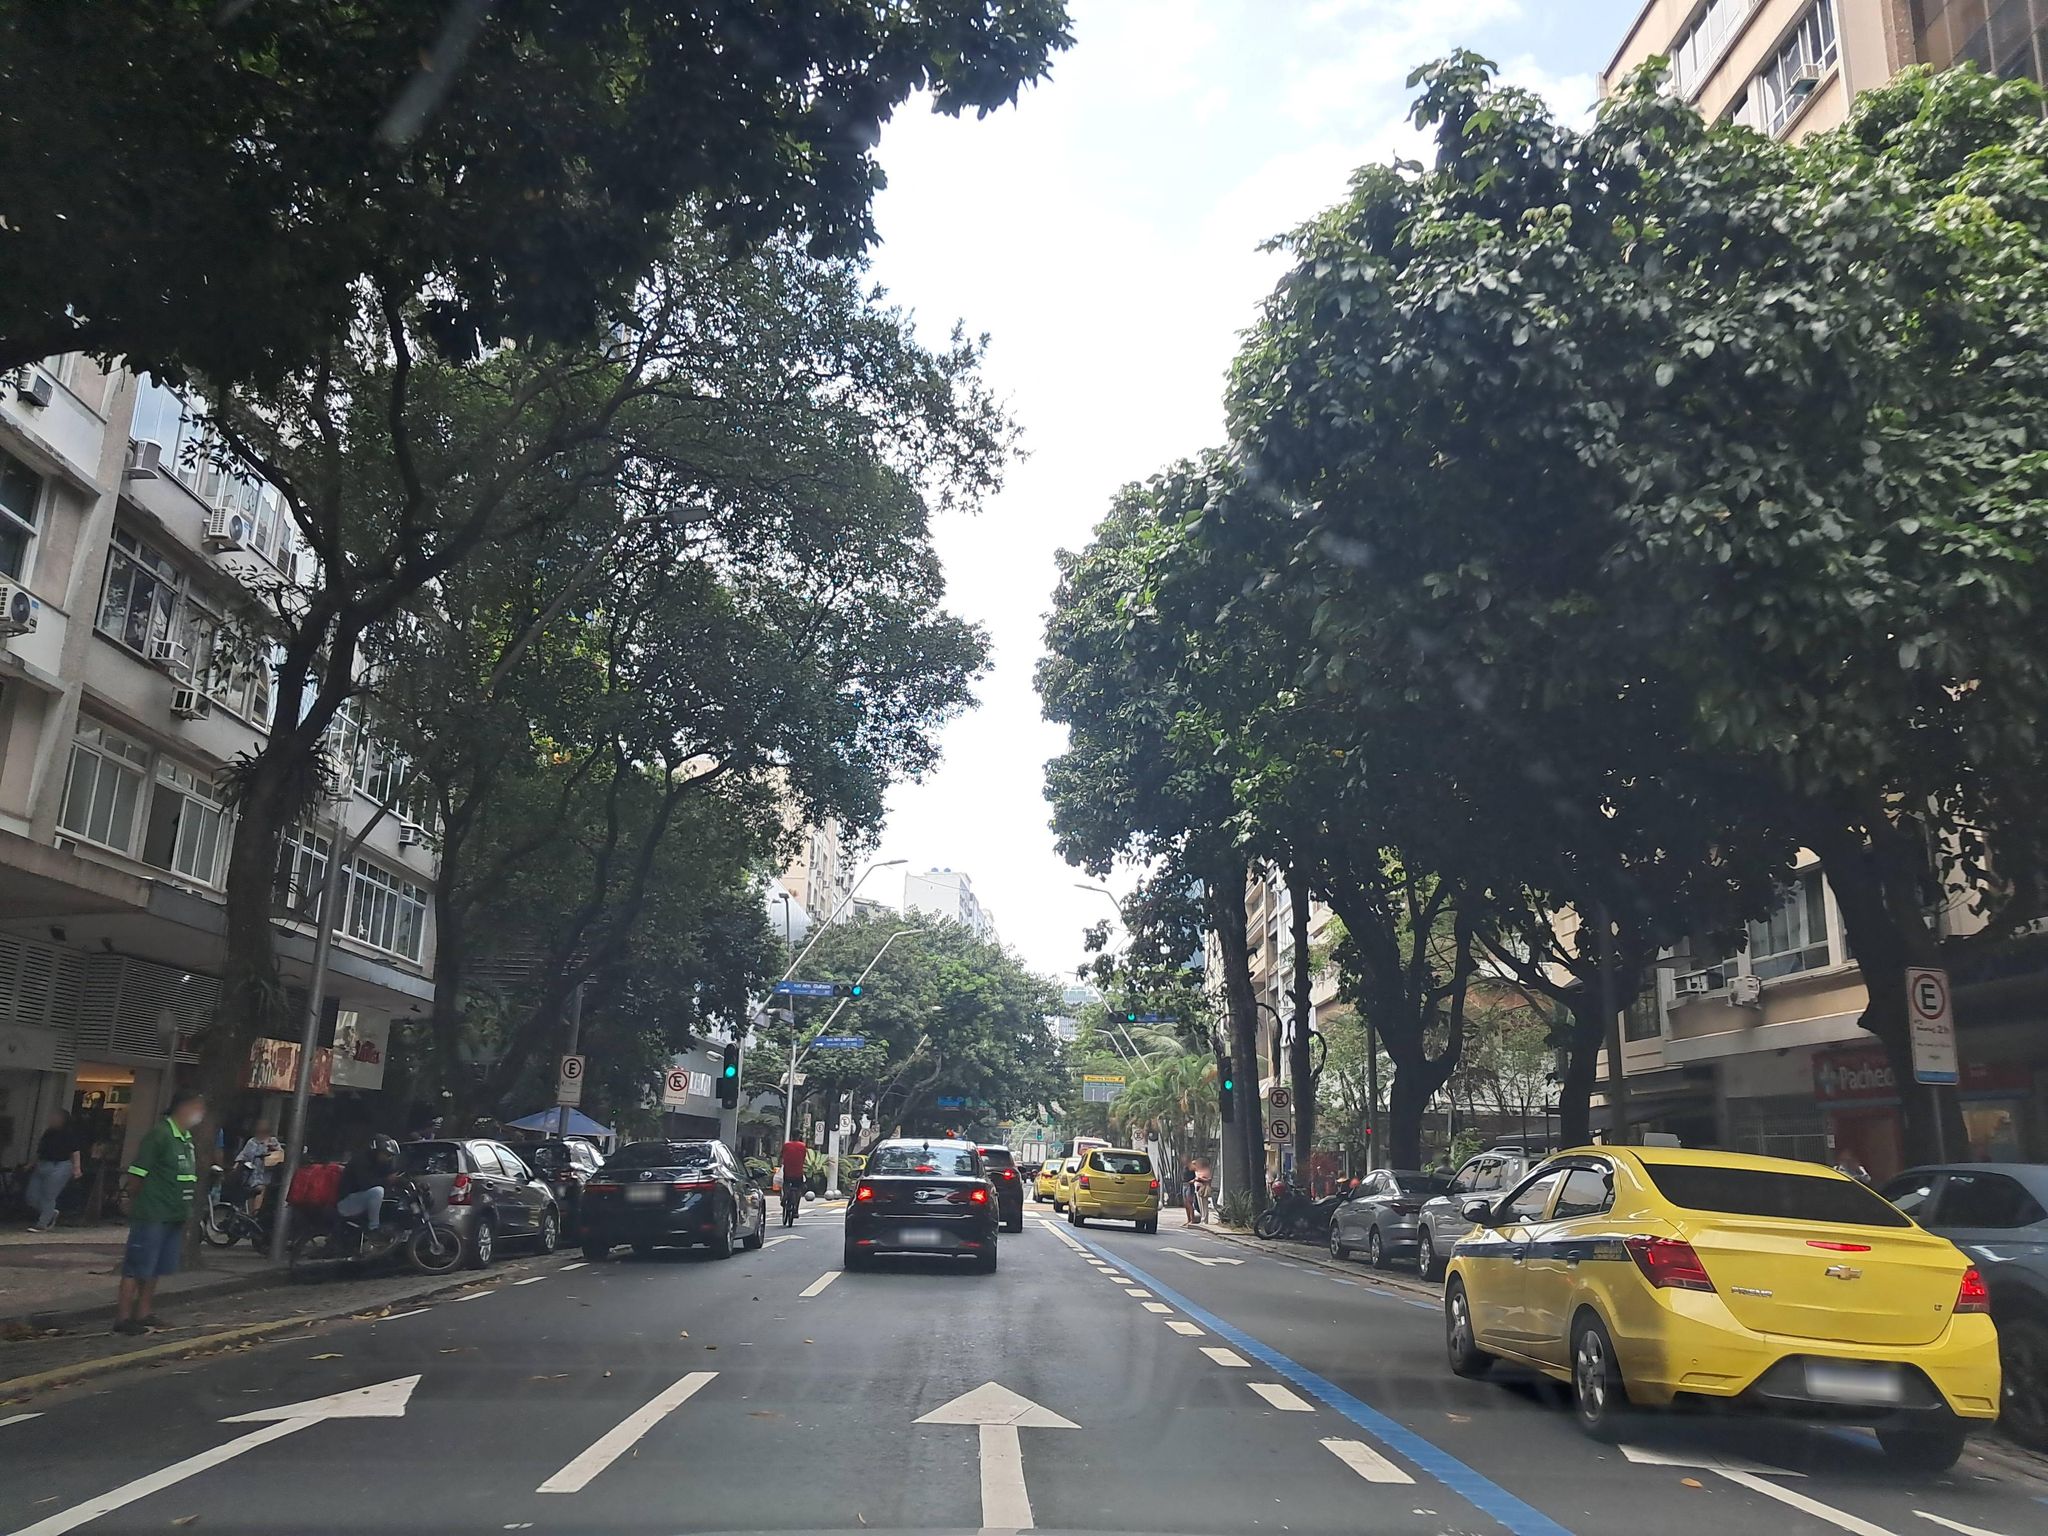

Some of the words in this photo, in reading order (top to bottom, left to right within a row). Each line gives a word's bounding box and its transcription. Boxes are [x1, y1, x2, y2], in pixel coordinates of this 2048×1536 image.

[1920, 984, 1937, 1009] E
[568, 1062, 576, 1074] E
[1840, 1063, 1896, 1091] Pachec
